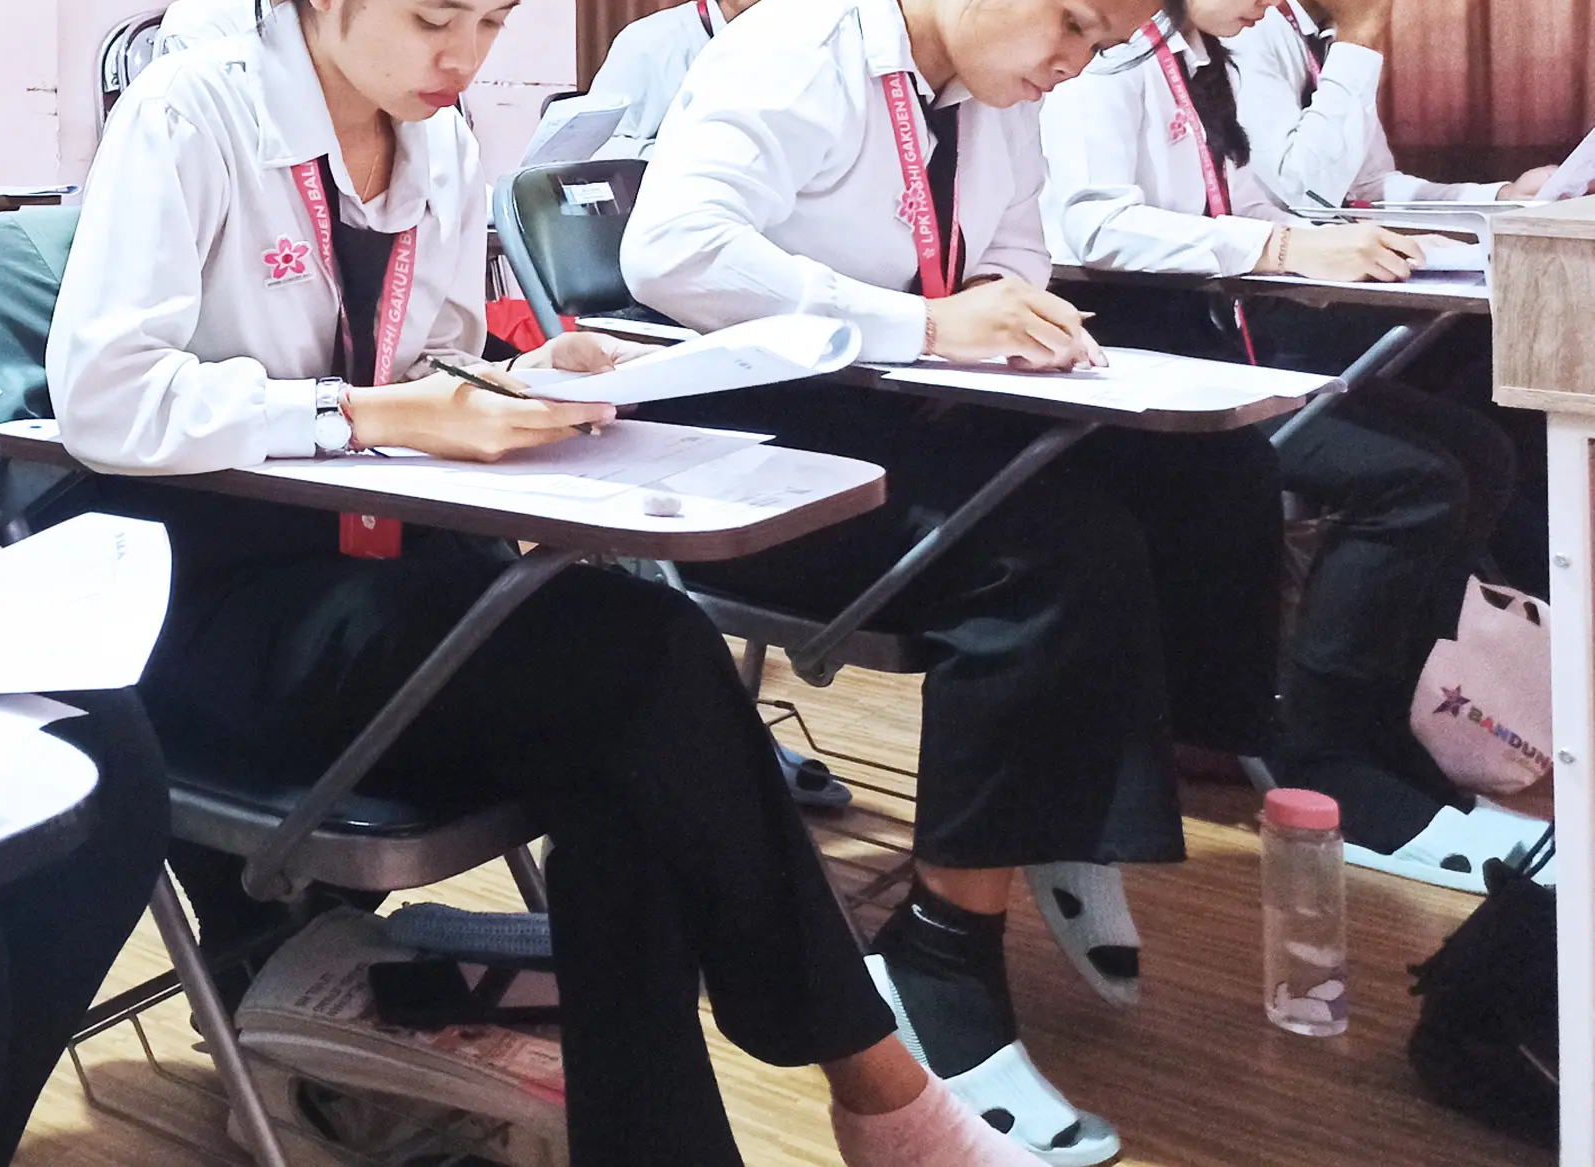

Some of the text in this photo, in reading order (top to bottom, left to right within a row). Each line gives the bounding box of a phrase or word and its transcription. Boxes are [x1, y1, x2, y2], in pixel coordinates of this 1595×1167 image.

[894, 101, 917, 163] GAKUEN
[313, 205, 331, 269] AKUEN
[917, 214, 934, 243] LPK
[388, 252, 411, 323] GAKUEN
[378, 323, 399, 385] HOSHI
